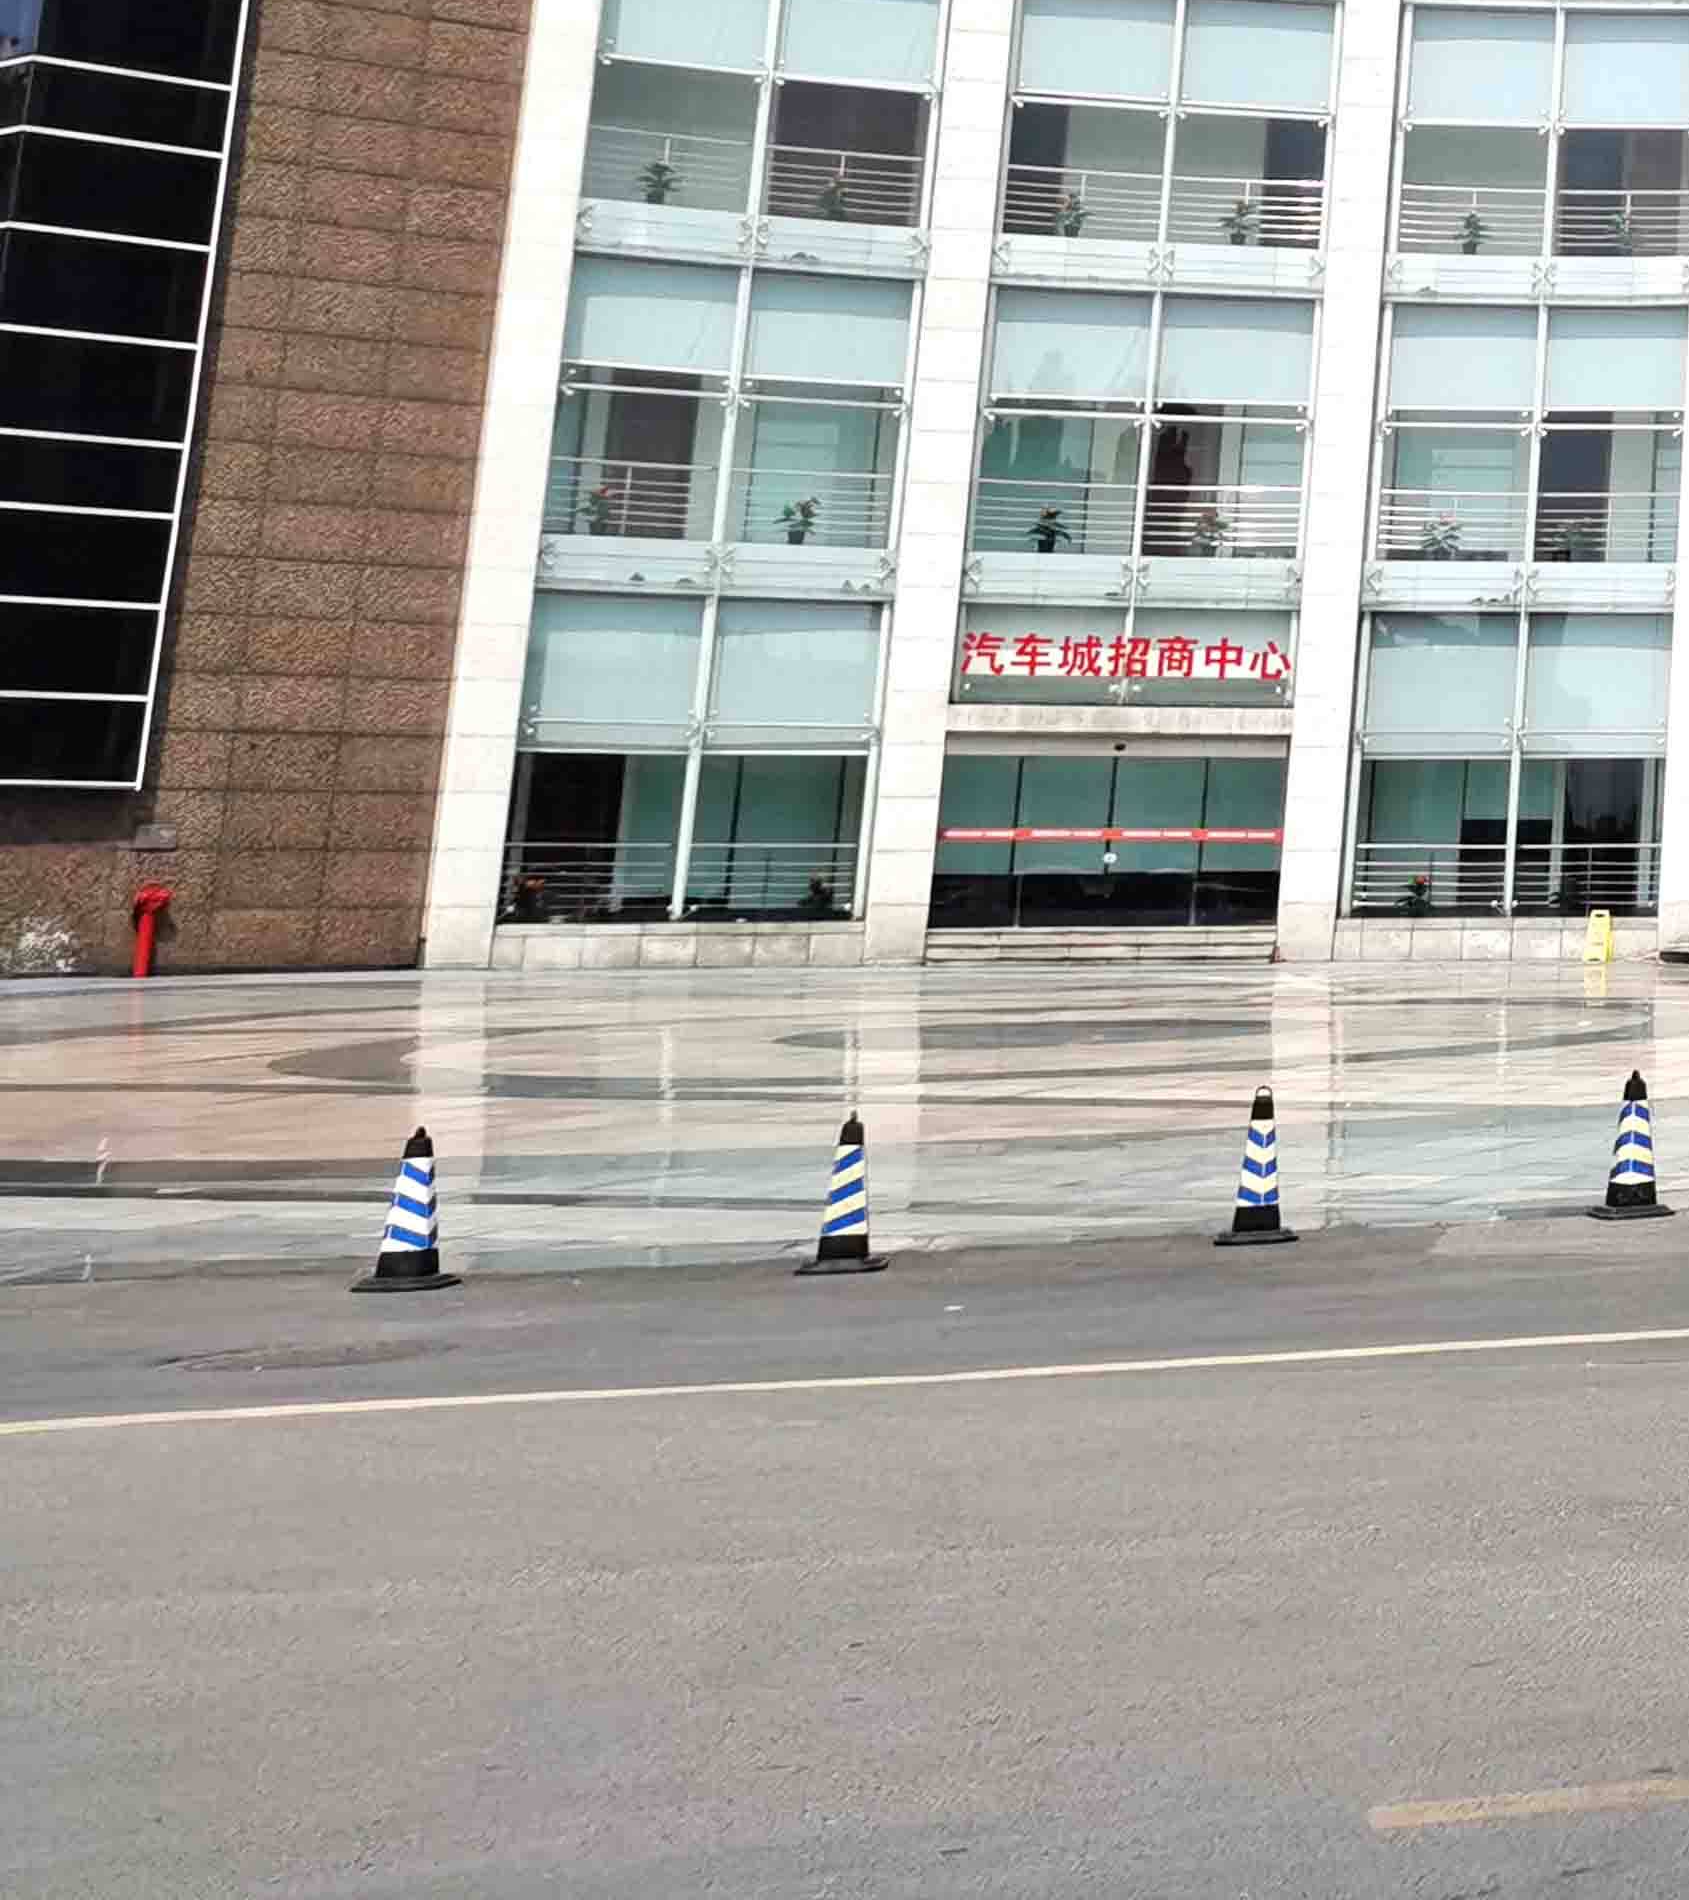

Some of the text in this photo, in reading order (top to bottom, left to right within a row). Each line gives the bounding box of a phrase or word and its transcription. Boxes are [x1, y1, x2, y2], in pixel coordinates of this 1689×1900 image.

[960, 631, 1292, 680] 汽车城招商中心
